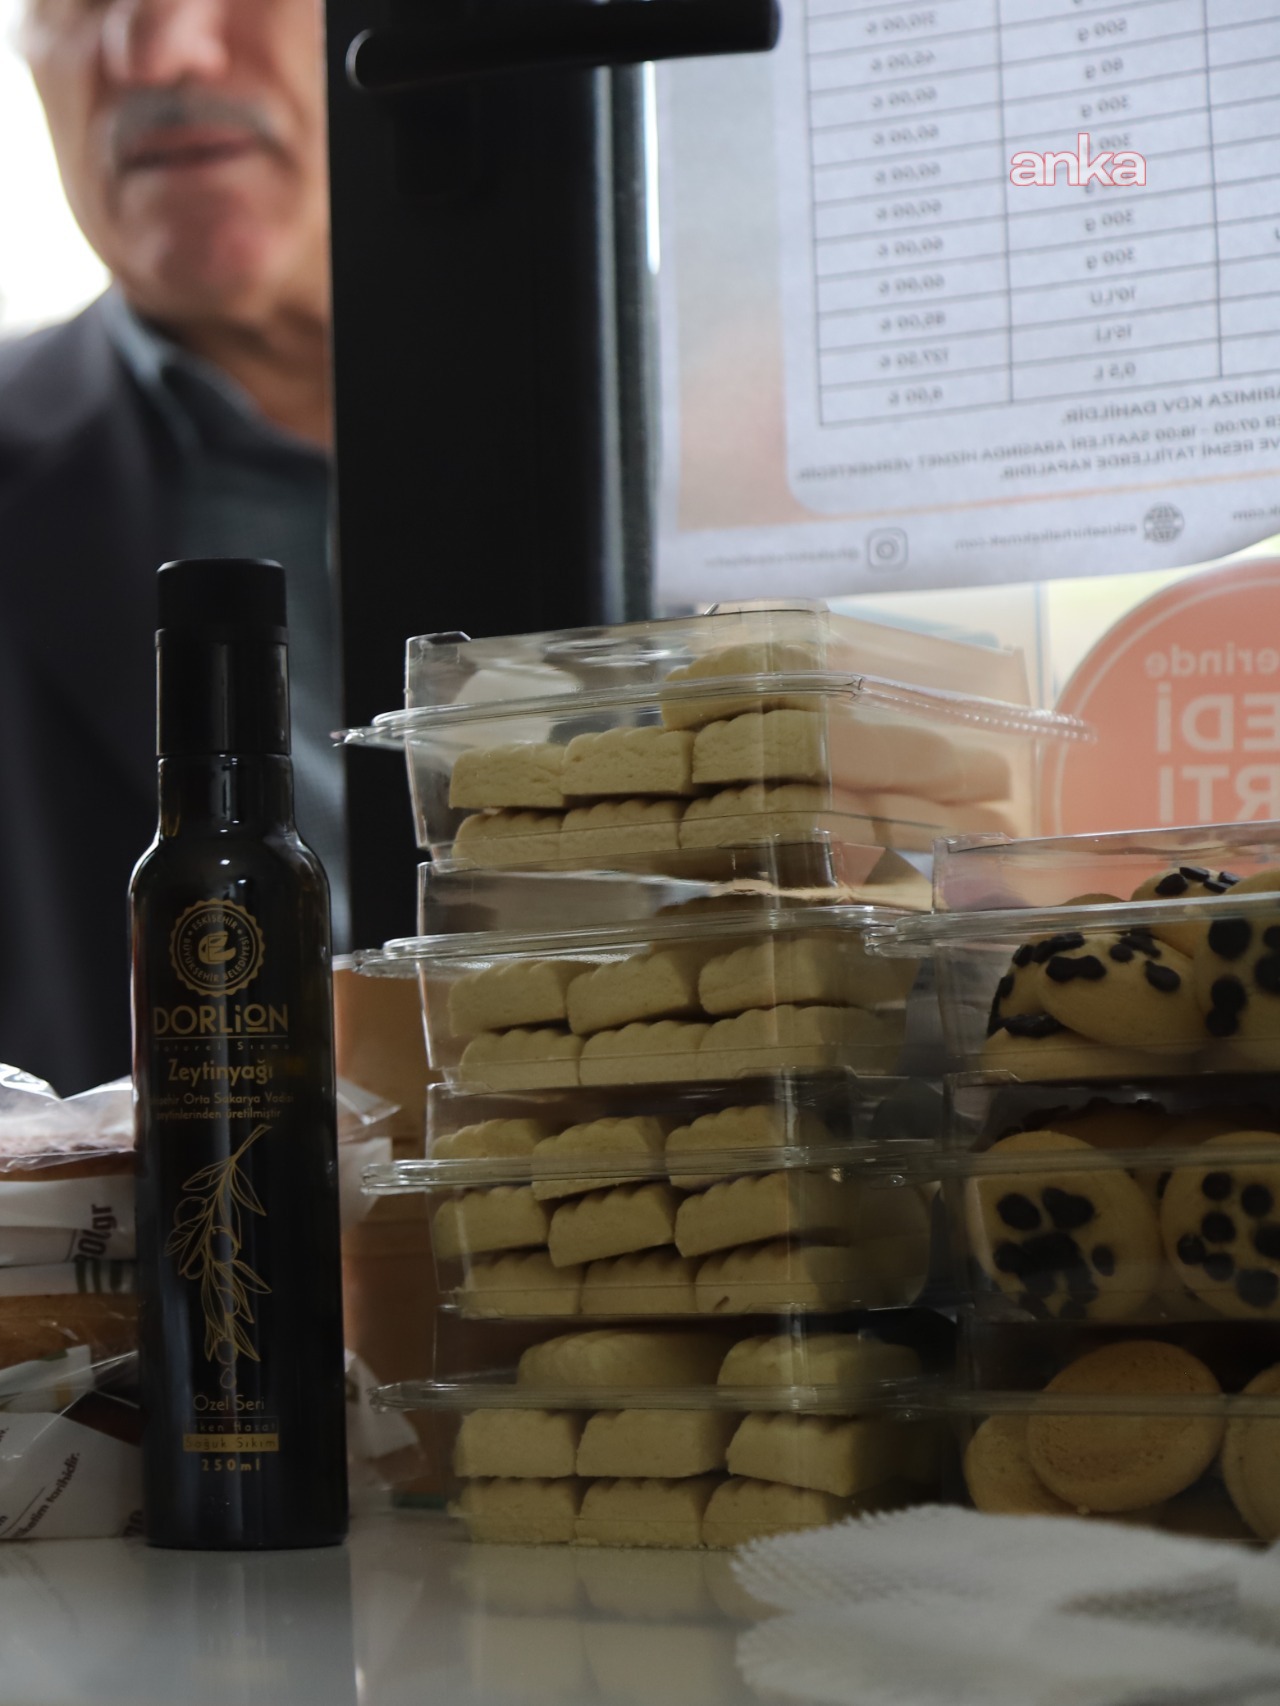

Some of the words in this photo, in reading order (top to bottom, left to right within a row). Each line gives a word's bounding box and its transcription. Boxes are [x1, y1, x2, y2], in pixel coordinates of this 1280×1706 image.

[167, 1058, 273, 1088] Zeytinyağı
[183, 1093, 210, 1104] Orta
[234, 1394, 265, 1411] Seri
